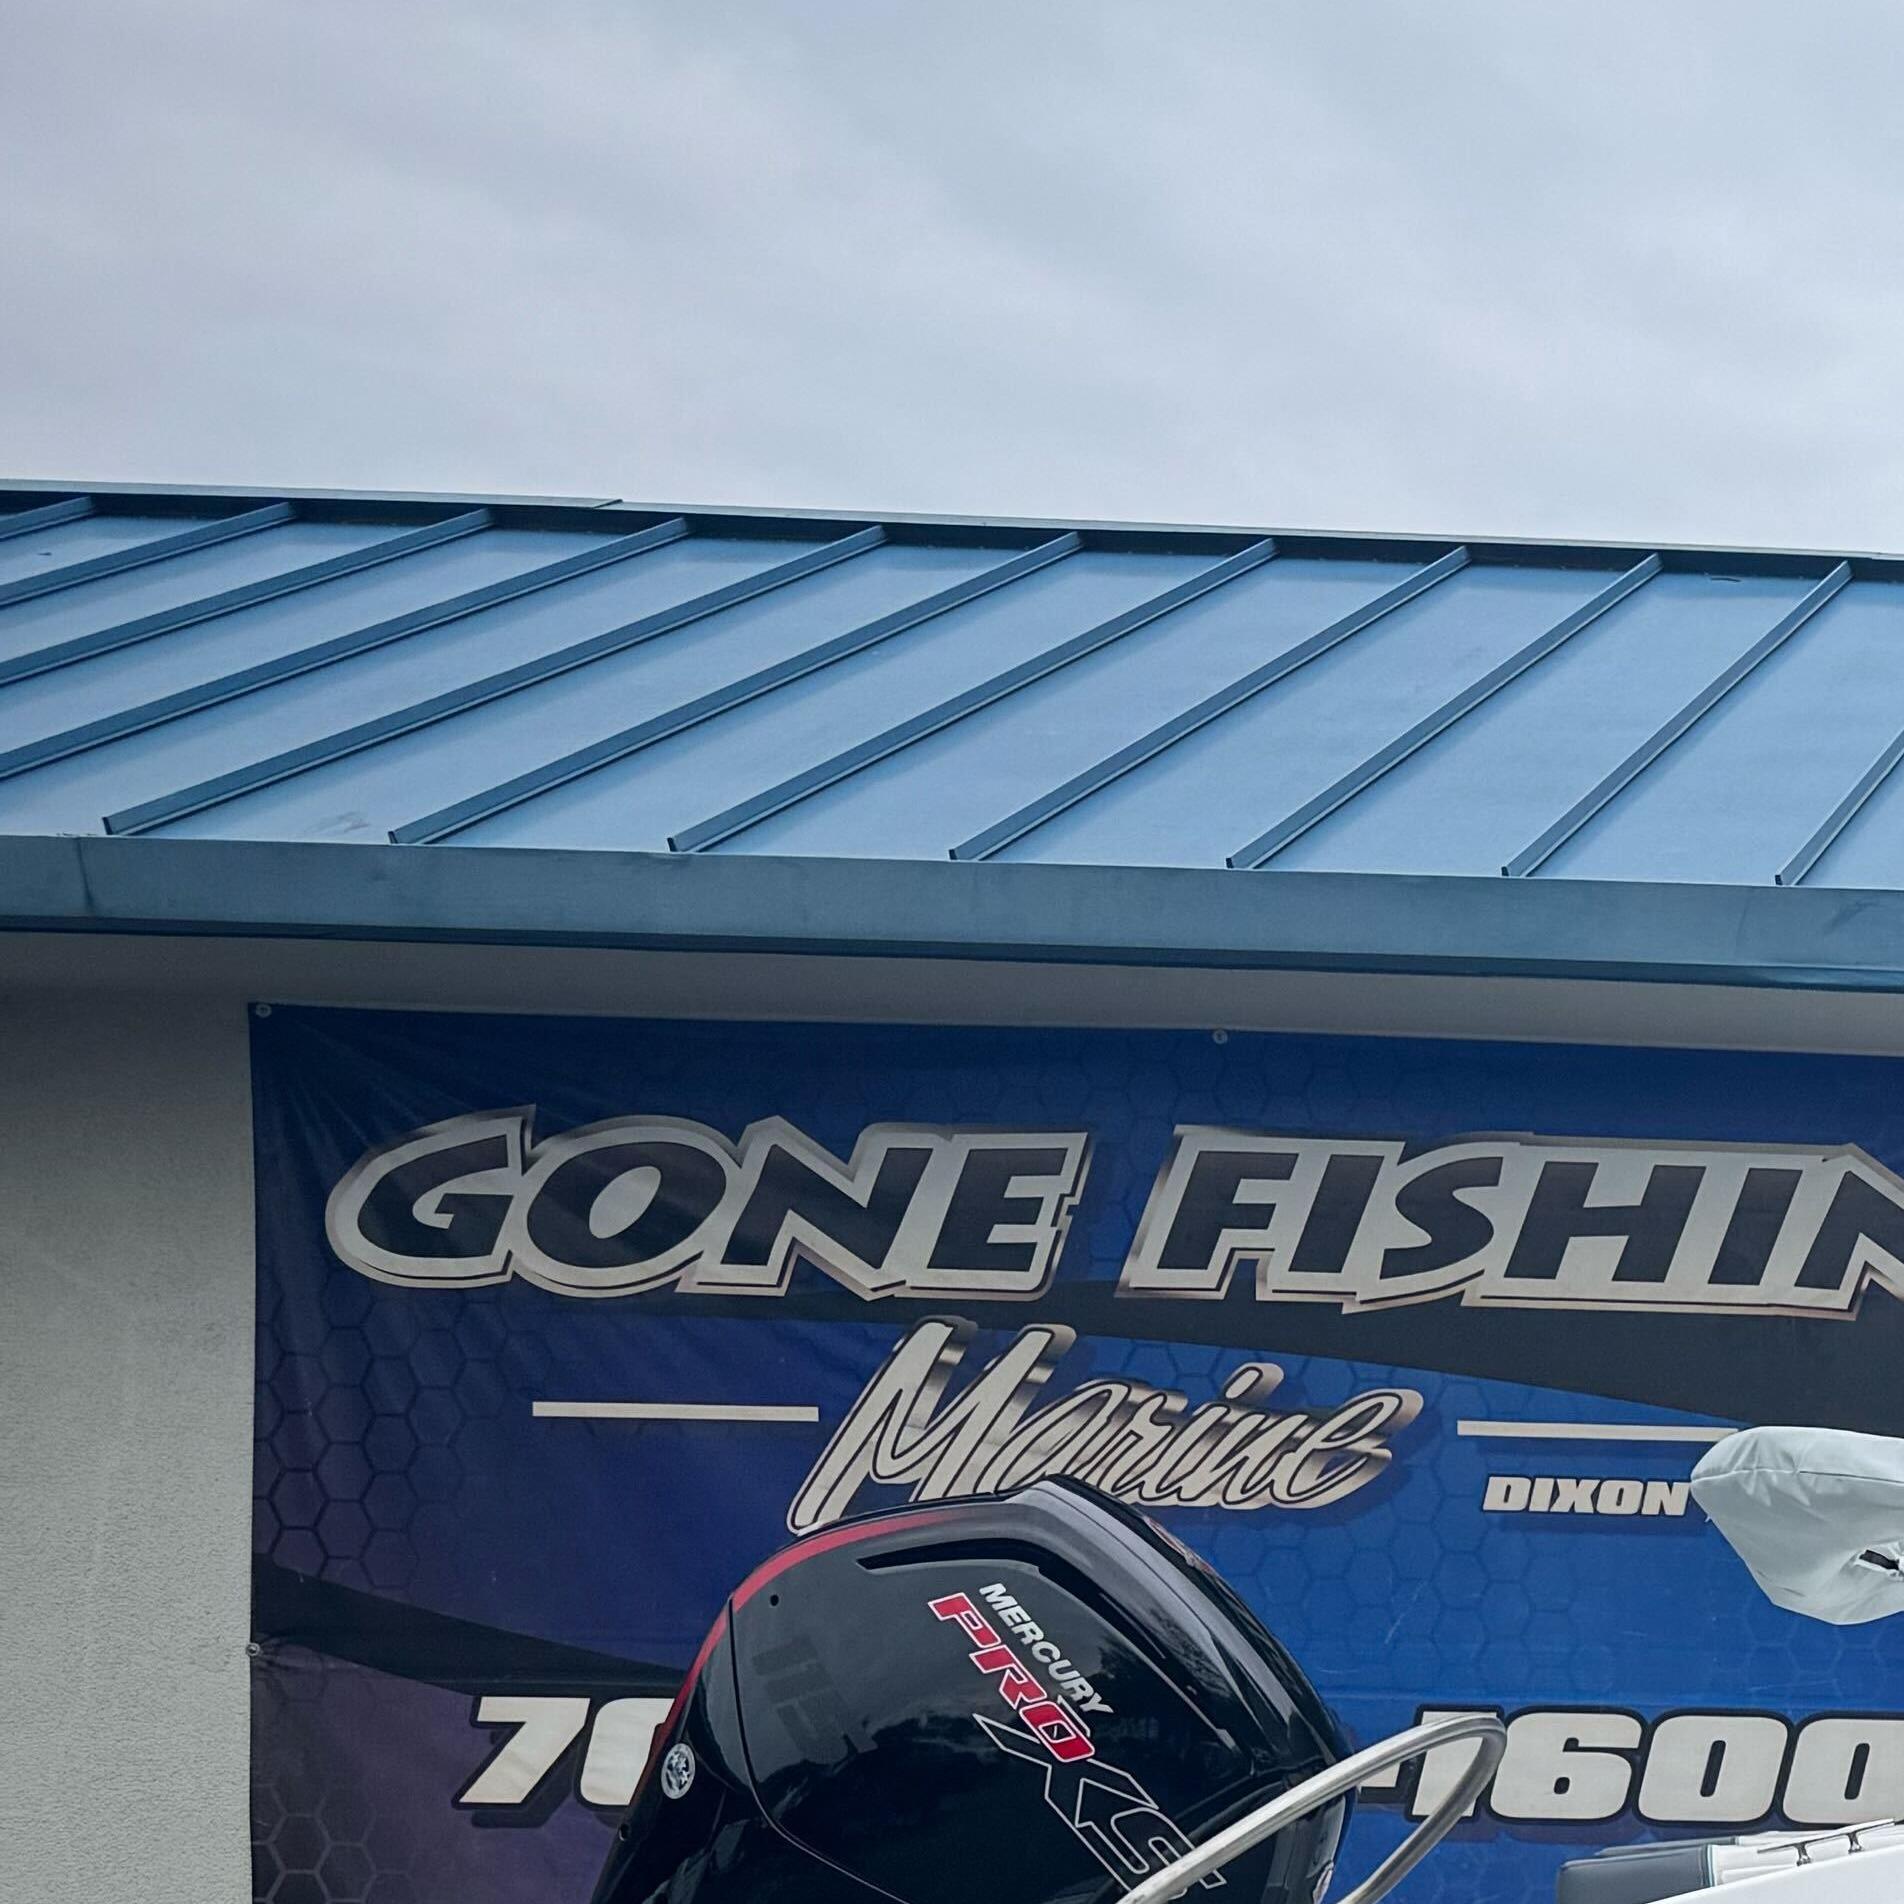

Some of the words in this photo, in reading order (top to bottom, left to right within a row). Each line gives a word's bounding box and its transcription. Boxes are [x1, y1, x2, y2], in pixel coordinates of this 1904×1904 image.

[332, 1108, 1084, 1296] GONE
[787, 1316, 1424, 1534] Marine
[1483, 1475, 1691, 1517] DIXON
[927, 1592, 1096, 1763] PRO
[979, 1583, 1114, 1714] MERCURY
